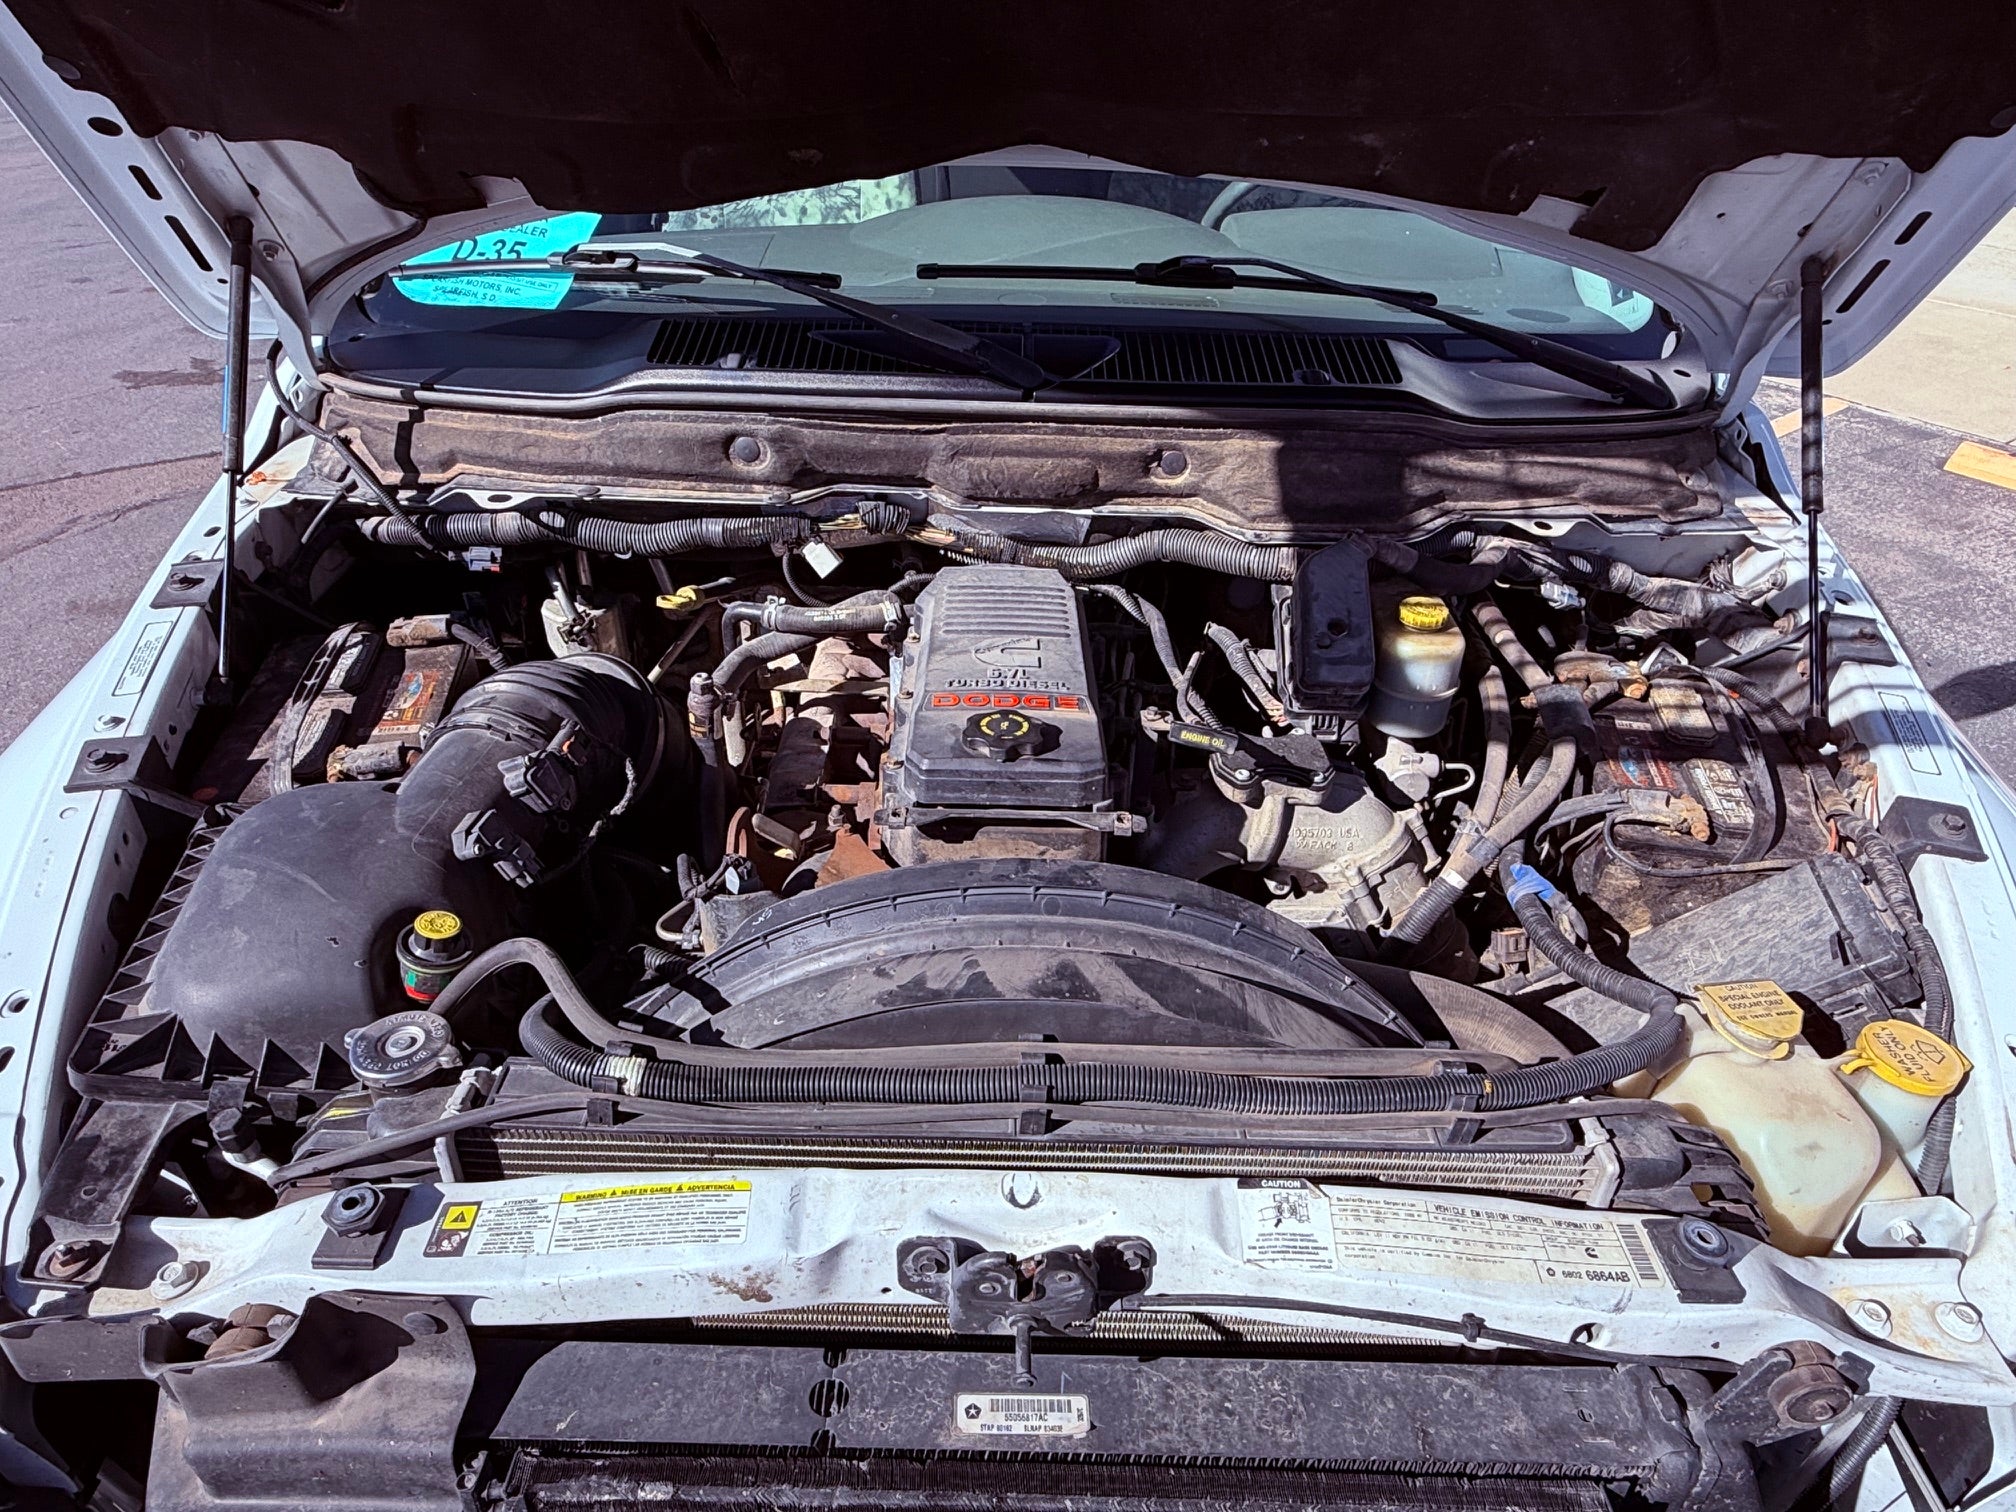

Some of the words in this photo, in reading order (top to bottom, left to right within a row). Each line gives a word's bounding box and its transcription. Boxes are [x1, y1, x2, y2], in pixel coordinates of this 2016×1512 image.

[931, 692, 1081, 710] DODGE
[1180, 730, 1211, 745] ENGINE
[1212, 737, 1226, 748] OIL
[1718, 994, 1751, 1003] SPECIAL
[1751, 990, 1782, 1000] ENGINE
[1728, 1000, 1764, 1010] COOLANT
[1764, 999, 1784, 1007] ONLY
[1879, 1026, 1906, 1051] ONLY
[1872, 1032, 1916, 1076] WASHER
[1904, 1053, 1936, 1082] FLUID
[575, 1192, 607, 1201] WARNING
[686, 1183, 735, 1192] ADVERTENCIA
[1261, 1179, 1301, 1189] CAUTION
[1434, 1204, 1466, 1215] VEHICLE
[1470, 1209, 1509, 1220] EMISSION
[1512, 1214, 1547, 1225] CONTROL
[1551, 1220, 1604, 1230] INFORMATION
[1585, 1269, 1631, 1282] 6864AB
